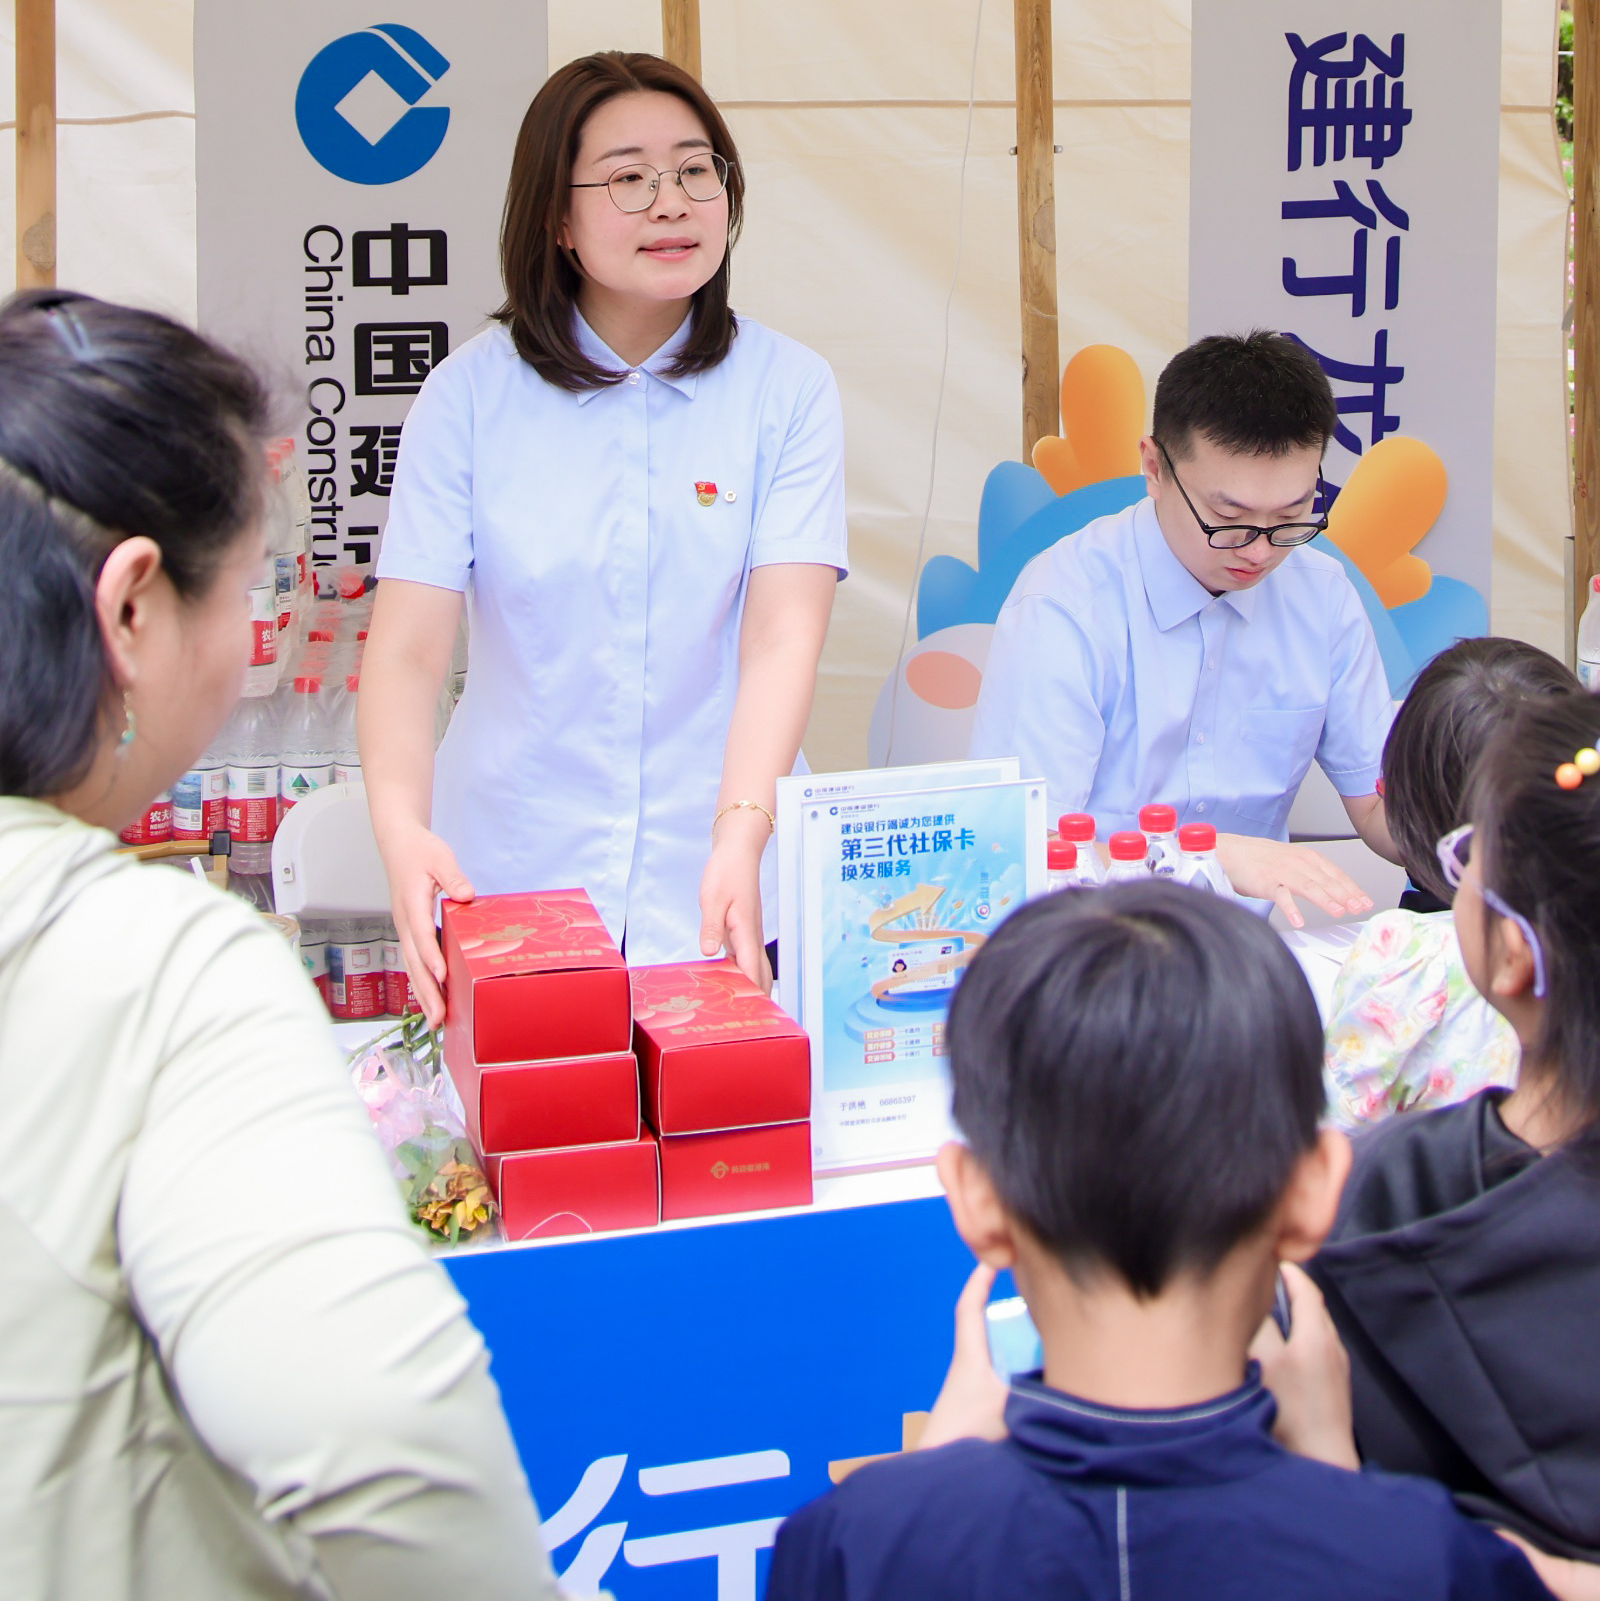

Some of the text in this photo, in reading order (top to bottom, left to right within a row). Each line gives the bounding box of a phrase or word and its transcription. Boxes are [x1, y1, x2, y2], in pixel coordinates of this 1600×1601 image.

[1280, 31, 1413, 523] 建行龙
[302, 224, 346, 568] China Constru
[343, 222, 449, 566] 中国建
[840, 813, 956, 836] 建设银行竭诚为您提供
[840, 827, 977, 861] 第三代社保卡
[840, 859, 912, 882] 换发服务
